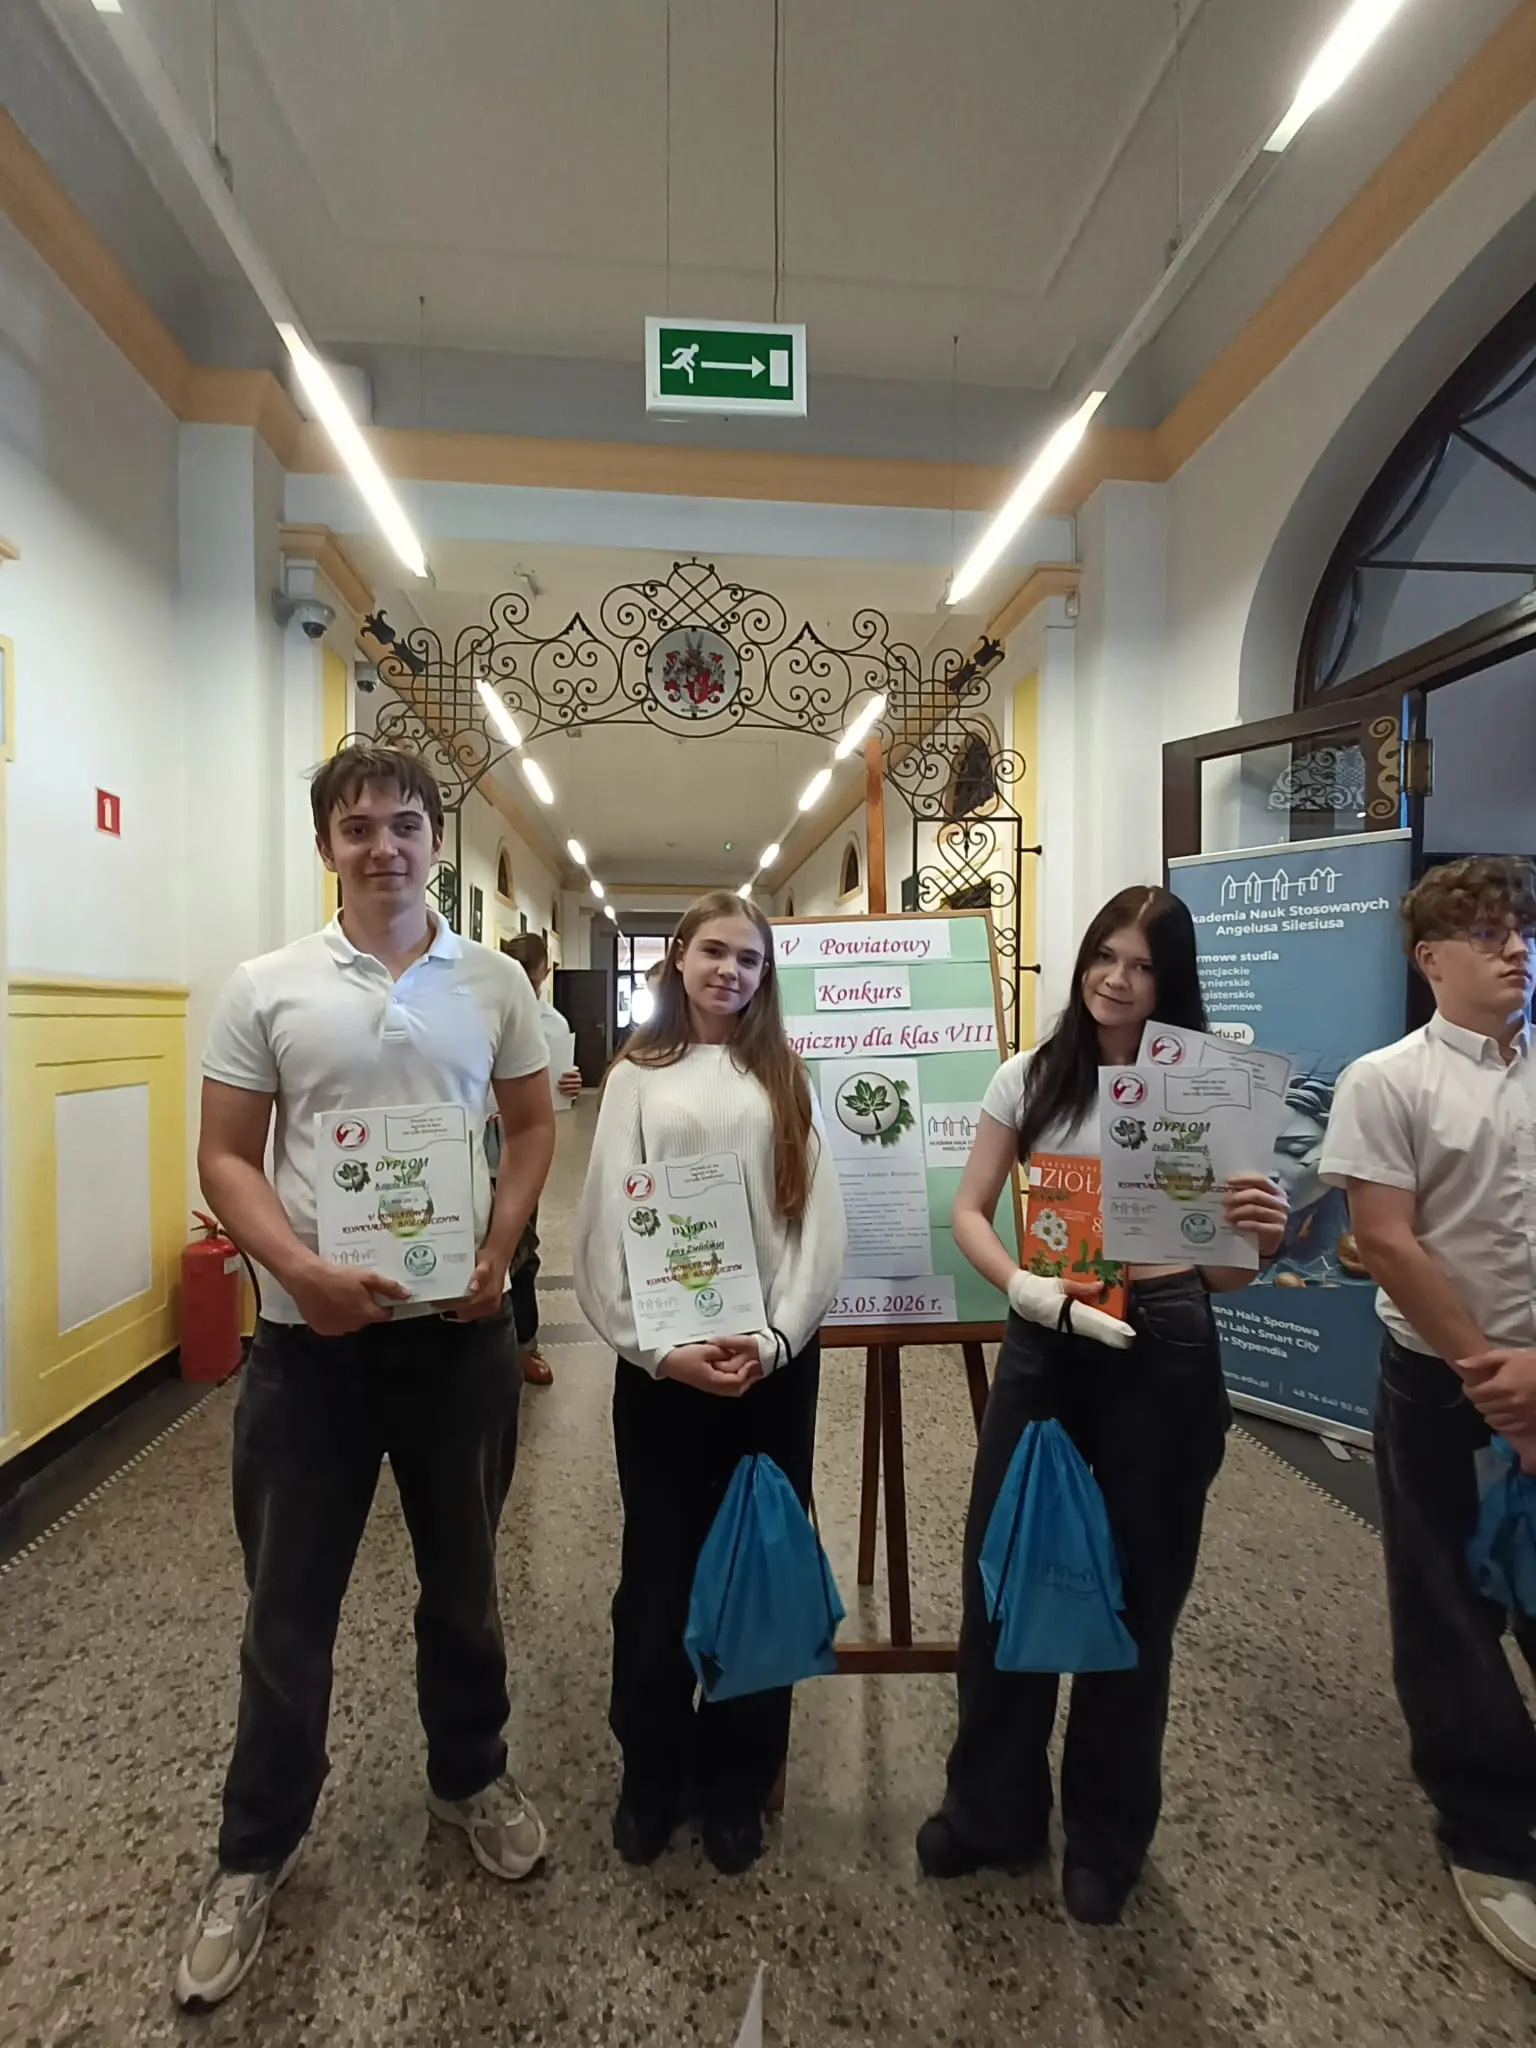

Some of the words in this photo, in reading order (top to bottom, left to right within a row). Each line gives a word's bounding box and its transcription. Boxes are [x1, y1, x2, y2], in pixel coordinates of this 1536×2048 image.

[1192, 910, 1246, 924] kademia
[1250, 907, 1285, 919] Nauk
[1289, 898, 1389, 917] Stosowanych
[1216, 922, 1278, 936] Angelusa
[1282, 918, 1344, 932] Silesiusa
[780, 937, 800, 956] V
[819, 936, 931, 958] Powiatowy
[1196, 954, 1238, 962] rmowe
[1240, 950, 1280, 961] studia
[1198, 967, 1250, 977] encjackie
[1199, 978, 1251, 989] ynierskie
[818, 981, 903, 1005] Konkurs
[1202, 990, 1256, 1001] gisterskie
[1204, 1003, 1263, 1013] yplomowe
[787, 1031, 858, 1055] ogiczny
[862, 1026, 893, 1048] dla
[899, 1025, 940, 1050] klas
[945, 1022, 994, 1044] VIII
[1214, 1029, 1246, 1040] du.pl
[1152, 1121, 1211, 1133] DYPLOM
[375, 1157, 430, 1172] DYPLOM
[1043, 1167, 1102, 1195] ZIOŁ
[828, 1295, 926, 1314] 25.05.2026
[930, 1297, 943, 1311] r.
[1236, 1309, 1261, 1323] Hala
[1263, 1315, 1320, 1337] Sportowa
[1229, 1322, 1250, 1334] Lab
[1258, 1328, 1293, 1346] Smart
[1296, 1337, 1320, 1353] City
[1231, 1336, 1288, 1358] Stypendia
